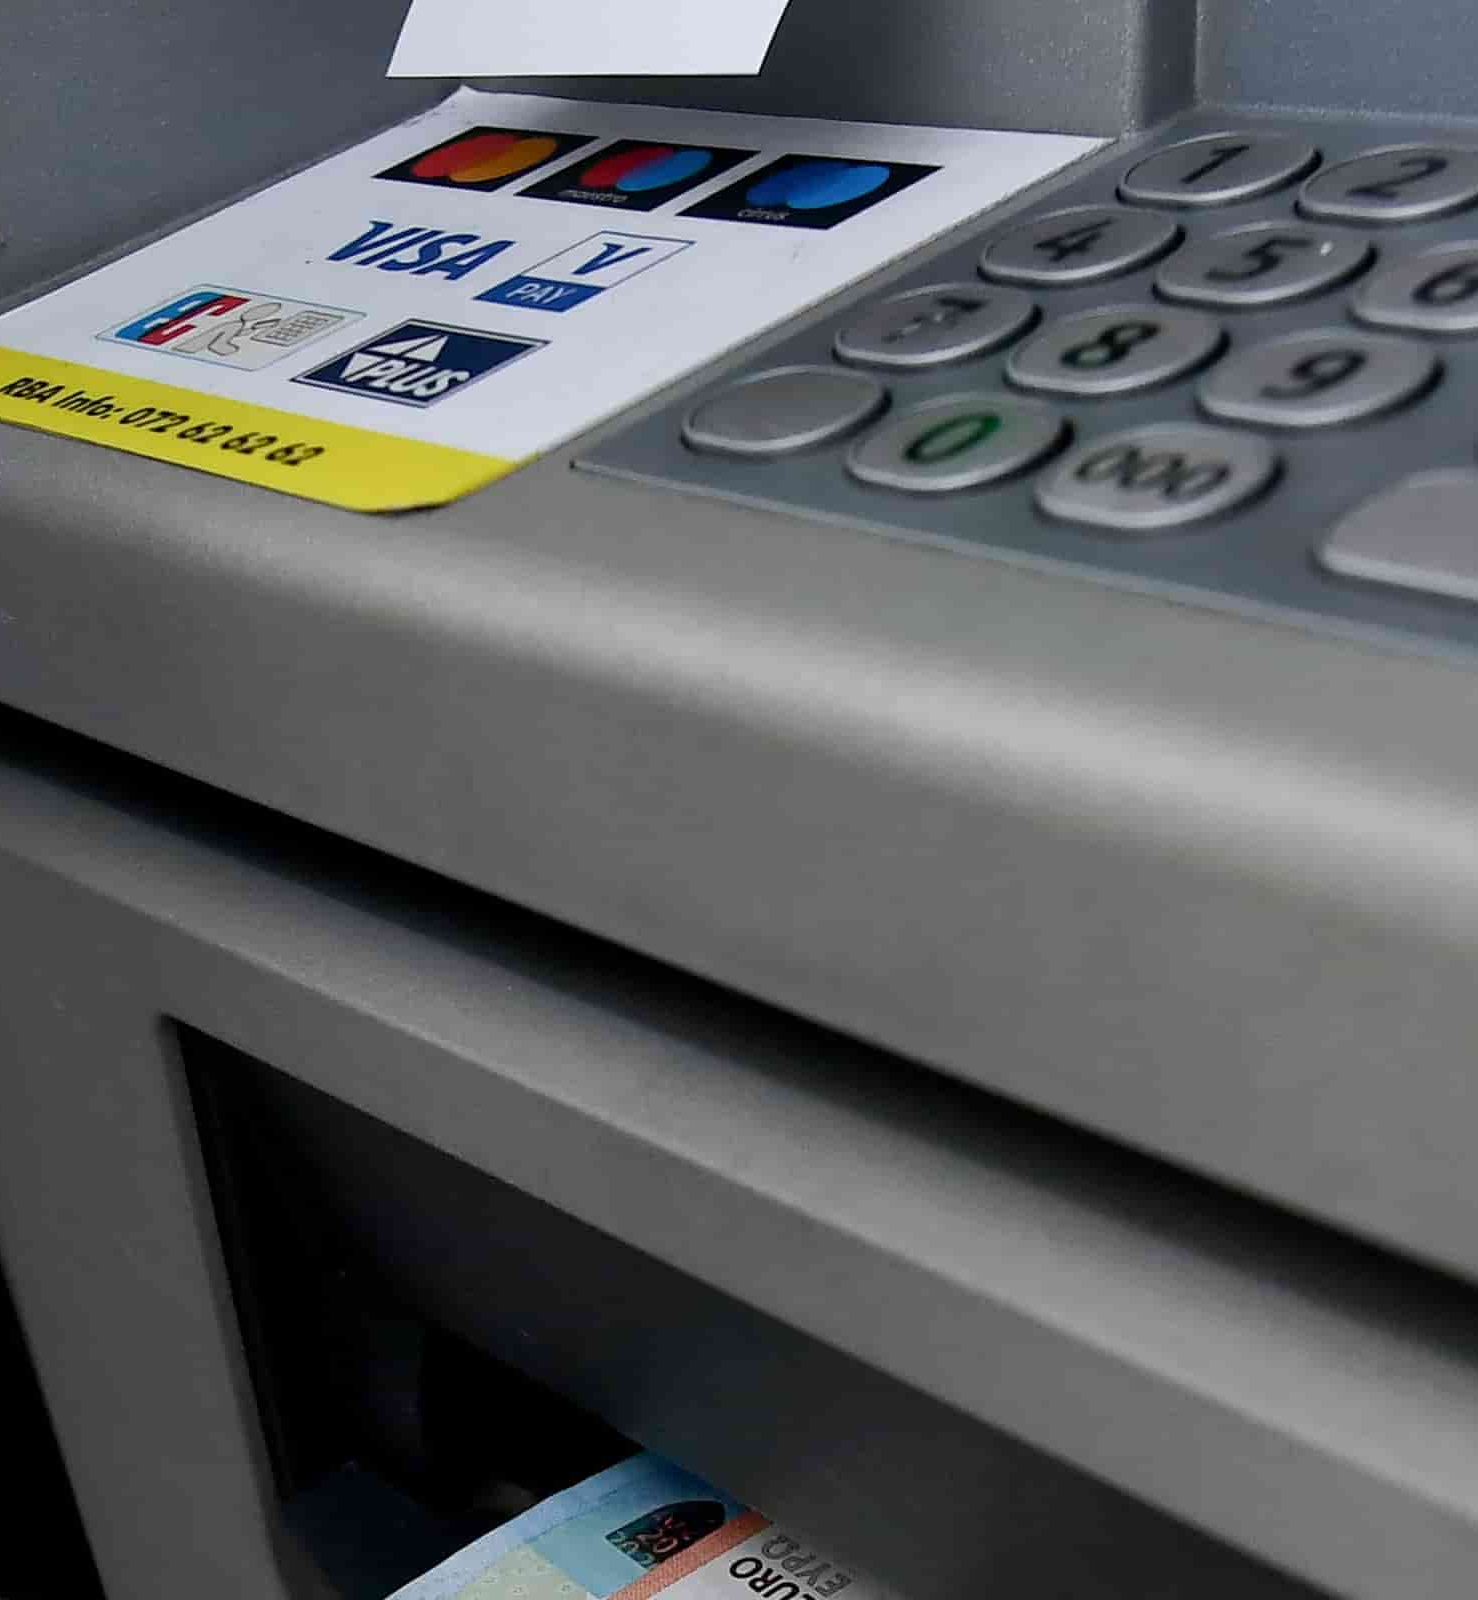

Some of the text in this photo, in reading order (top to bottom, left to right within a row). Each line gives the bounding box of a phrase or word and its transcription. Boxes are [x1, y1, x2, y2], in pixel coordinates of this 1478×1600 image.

[1179, 144, 1250, 184] 1
[1348, 156, 1449, 199] 2
[325, 220, 518, 282] VISA
[571, 241, 653, 275] V
[1033, 218, 1114, 263] 4
[1203, 235, 1315, 281] 5
[505, 282, 577, 305] PAY
[1059, 319, 1160, 368] 8
[359, 358, 471, 398] PLUS
[1259, 348, 1367, 399] 9
[52, 390, 123, 419] Info:
[118, 407, 190, 434] 072
[176, 421, 234, 445] 62
[220, 431, 278, 455] 62
[265, 442, 326, 467] 62
[902, 412, 1002, 464] 0
[1073, 443, 1233, 499] 000
